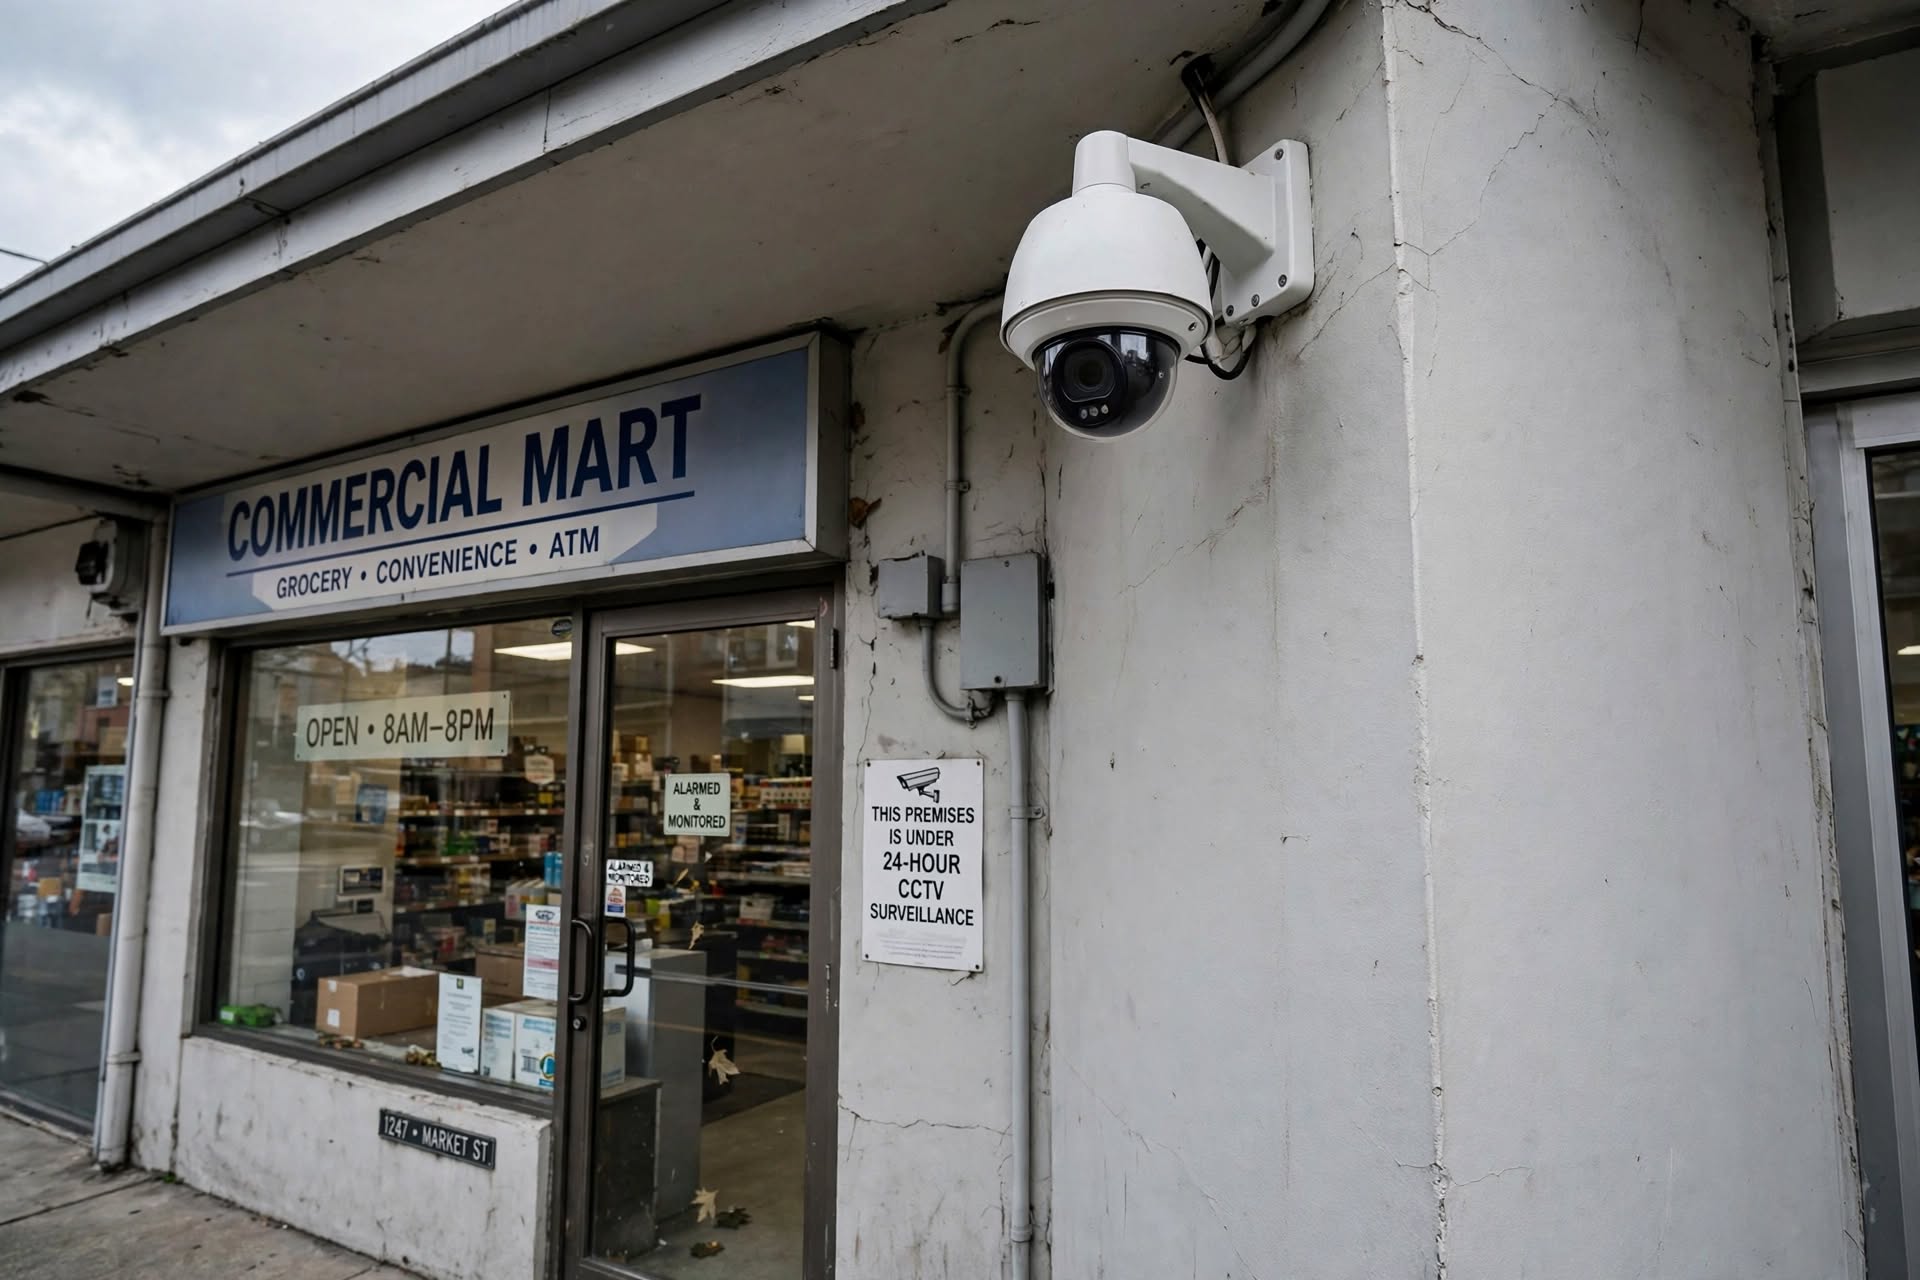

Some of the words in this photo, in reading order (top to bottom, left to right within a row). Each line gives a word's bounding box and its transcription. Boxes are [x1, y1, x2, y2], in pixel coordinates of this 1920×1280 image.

[228, 445, 502, 562] COMMERCIAL
[522, 394, 701, 507] MART
[276, 566, 353, 599] GROCERY
[376, 538, 518, 583] CONVENIENCE
[549, 525, 600, 560] ATM
[306, 715, 359, 748] OPEN
[673, 782, 721, 796] ALARMED
[693, 798, 701, 811] &
[872, 806, 901, 822] THIS
[905, 807, 975, 824] PREMISES
[668, 814, 726, 829] MONITORED
[889, 829, 901, 845] IS
[906, 830, 954, 847] UNDER
[883, 851, 960, 875] 24-HOUR
[898, 878, 944, 900] CCTV
[870, 903, 974, 926] SURVEILLANCE
[384, 1115, 409, 1139] 1247
[422, 1125, 468, 1157] MARKET
[472, 1138, 489, 1163] ST
